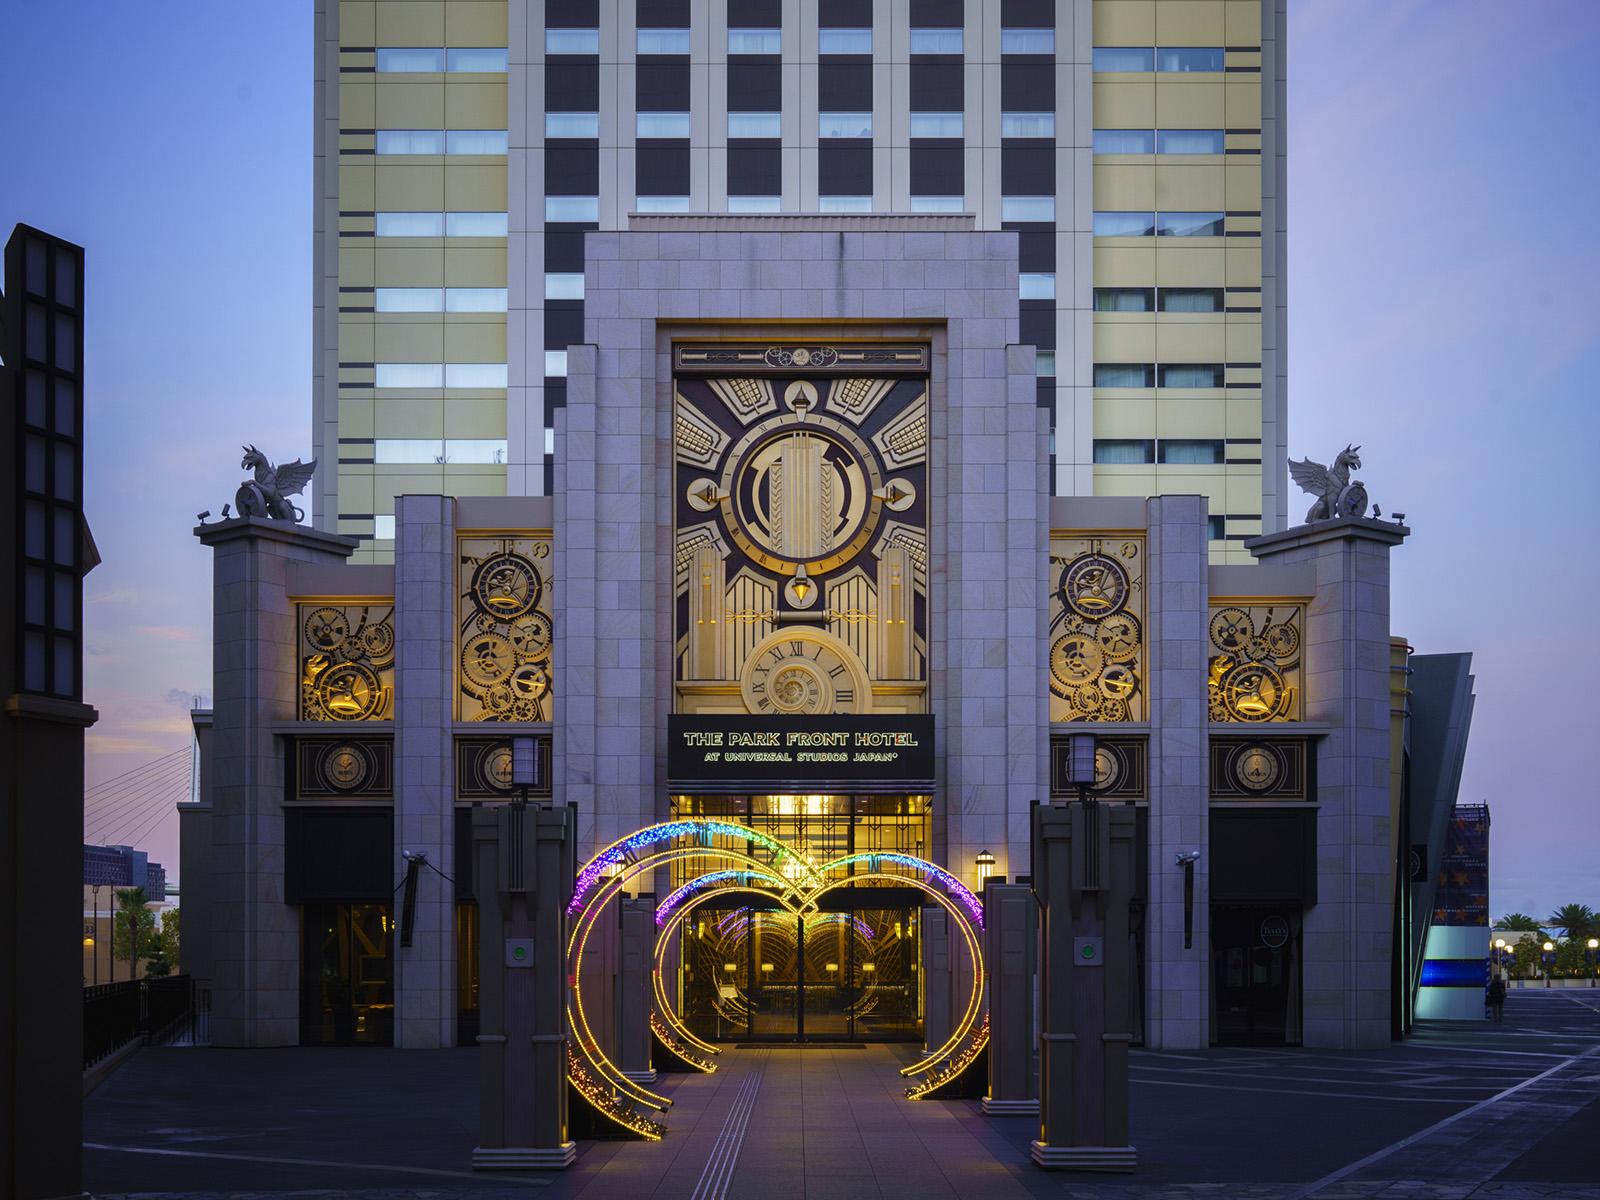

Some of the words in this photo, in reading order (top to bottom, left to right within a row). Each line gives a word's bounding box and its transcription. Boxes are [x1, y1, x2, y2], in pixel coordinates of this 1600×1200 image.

[769, 646, 785, 663] XI
[790, 641, 803, 656] XII
[813, 646, 823, 661] I
[755, 664, 769, 676] X
[828, 664, 846, 679] II
[753, 682, 764, 693] IX
[836, 689, 853, 704] III
[684, 732, 723, 746] THE
[729, 732, 780, 746] PARK
[787, 732, 849, 746] FRONT
[855, 732, 918, 746] HOTEL
[704, 752, 720, 761] AT
[725, 752, 792, 761] UNIVERSAL
[797, 752, 848, 761] STUDIOS
